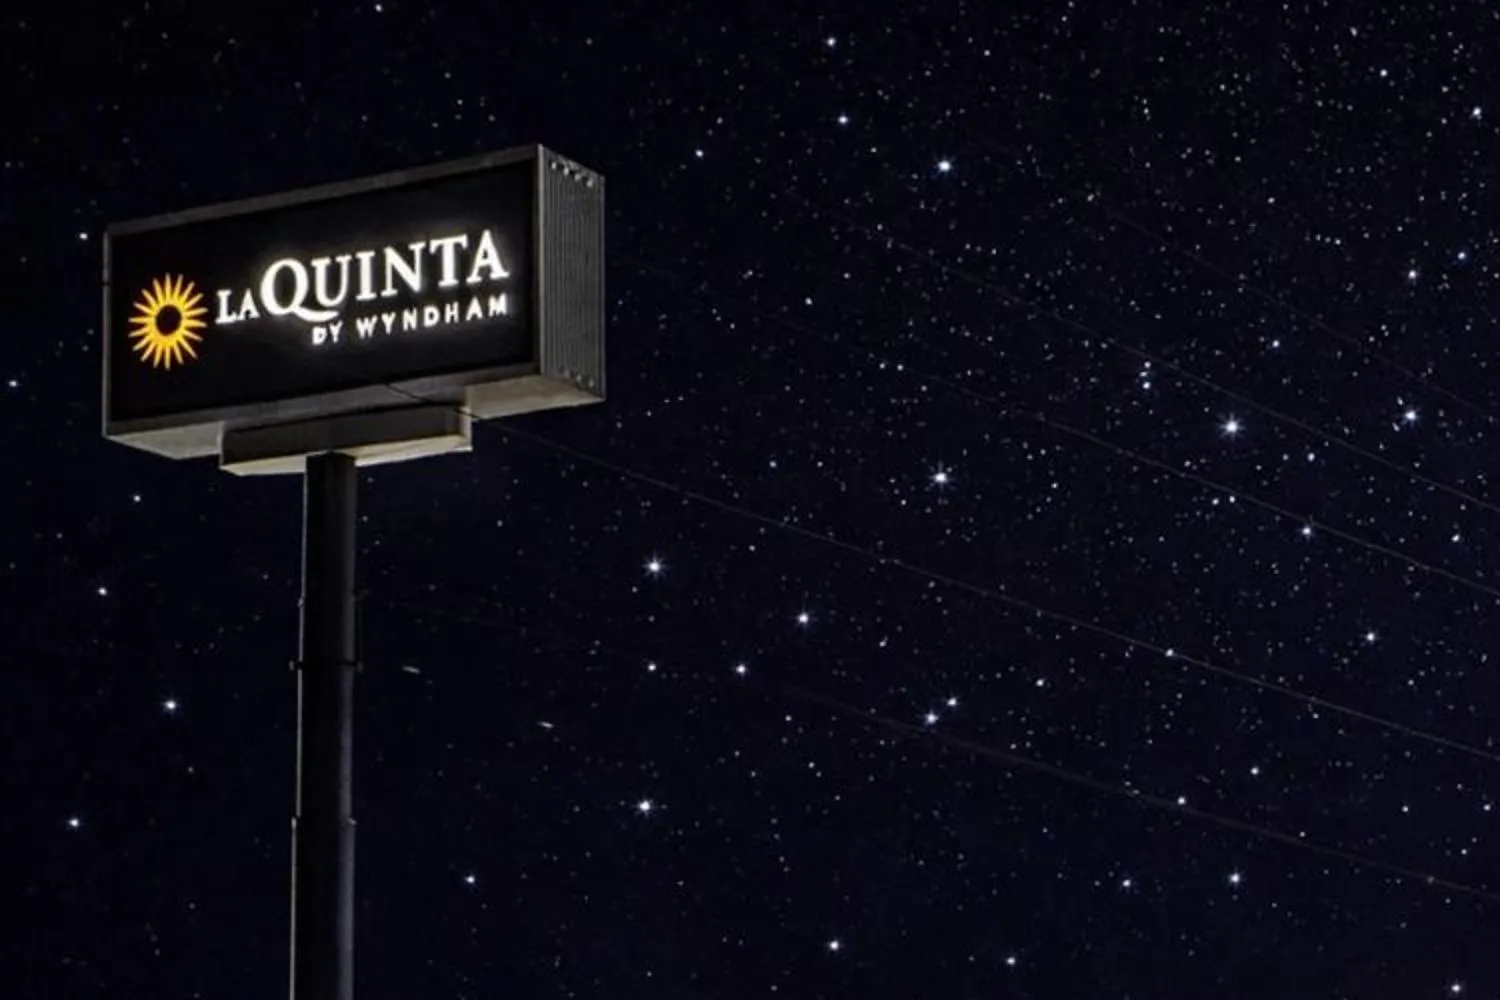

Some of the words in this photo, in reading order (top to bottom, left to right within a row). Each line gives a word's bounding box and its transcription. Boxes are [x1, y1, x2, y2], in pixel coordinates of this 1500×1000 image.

[215, 288, 260, 325] LA
[260, 229, 511, 323] QUINTA
[311, 320, 344, 346] BY
[355, 292, 508, 339] WYNDHAM
